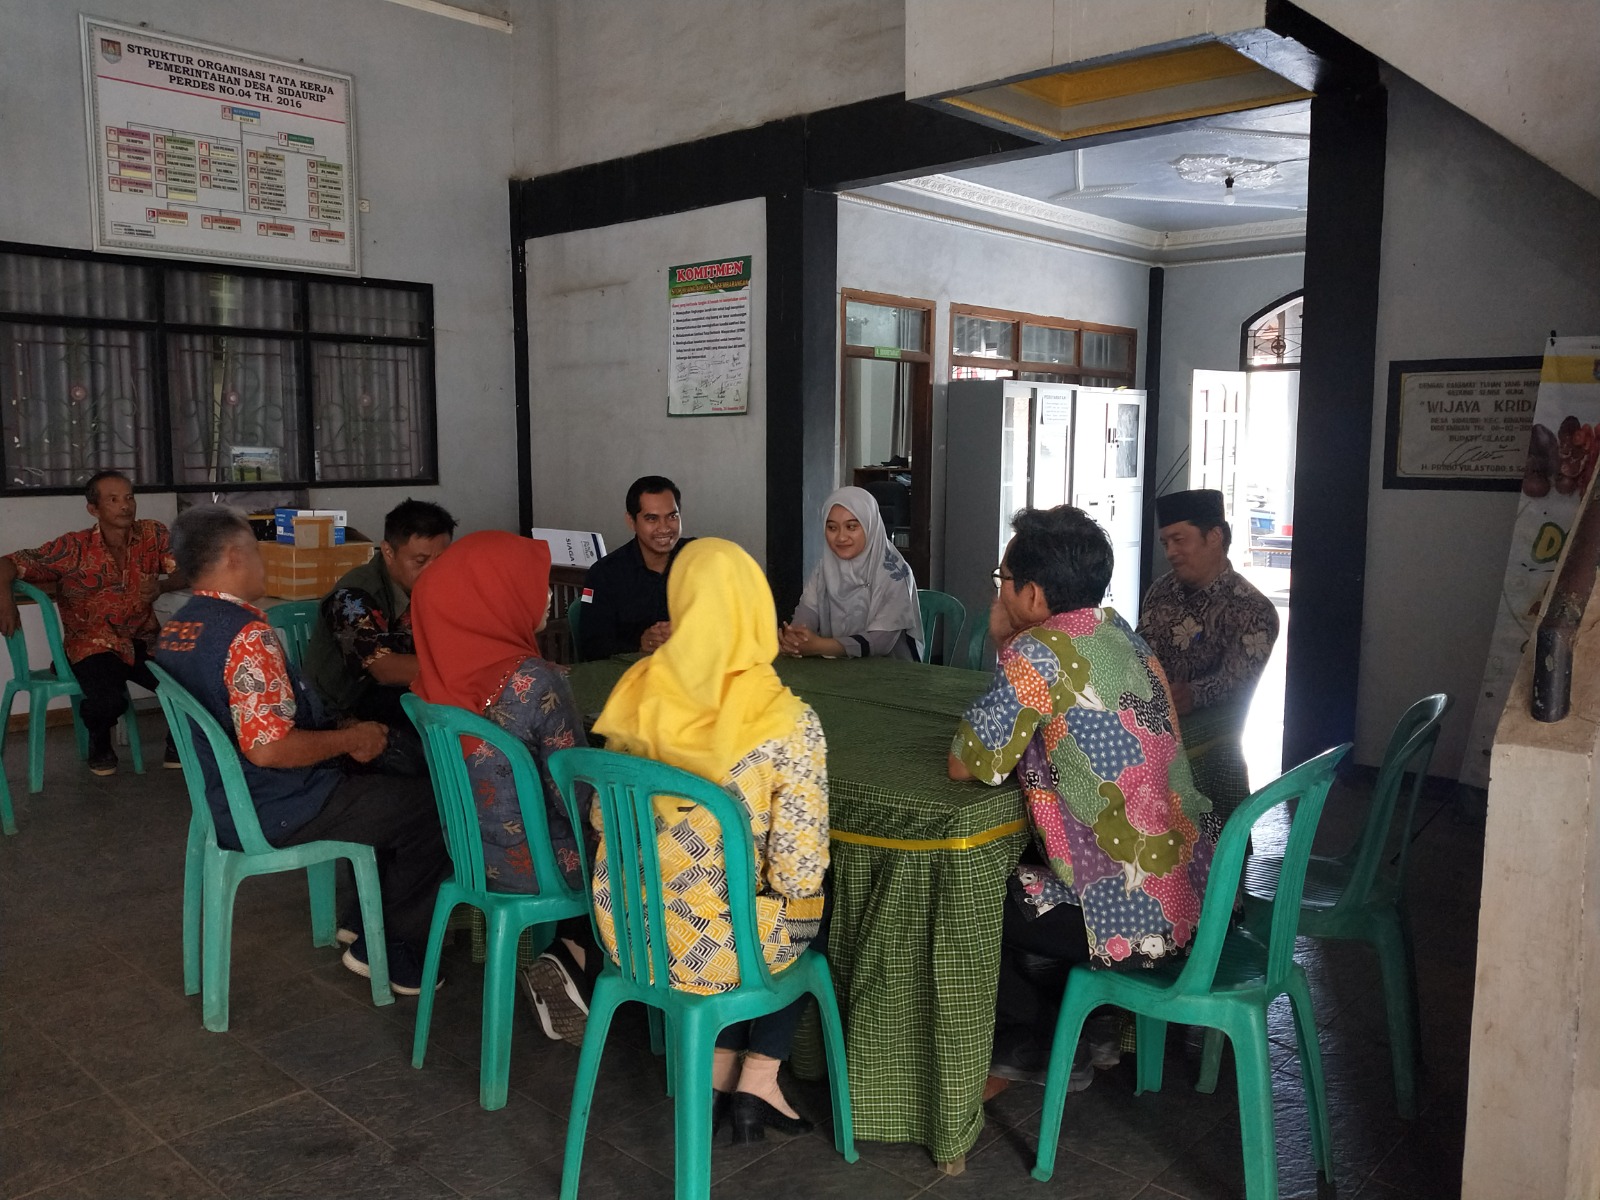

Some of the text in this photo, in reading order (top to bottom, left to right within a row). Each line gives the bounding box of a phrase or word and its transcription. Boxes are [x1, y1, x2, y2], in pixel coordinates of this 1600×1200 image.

[127, 43, 335, 95] STRUKTUR ORGANISASI TATA KERJA
[147, 59, 327, 103] PEMERINTAHAN DESA SIDAURIP
[168, 74, 302, 109] PERDES NO.04 TH. 2016
[676, 261, 744, 282] KOMITMEN
[565, 537, 575, 562] SIAGA
